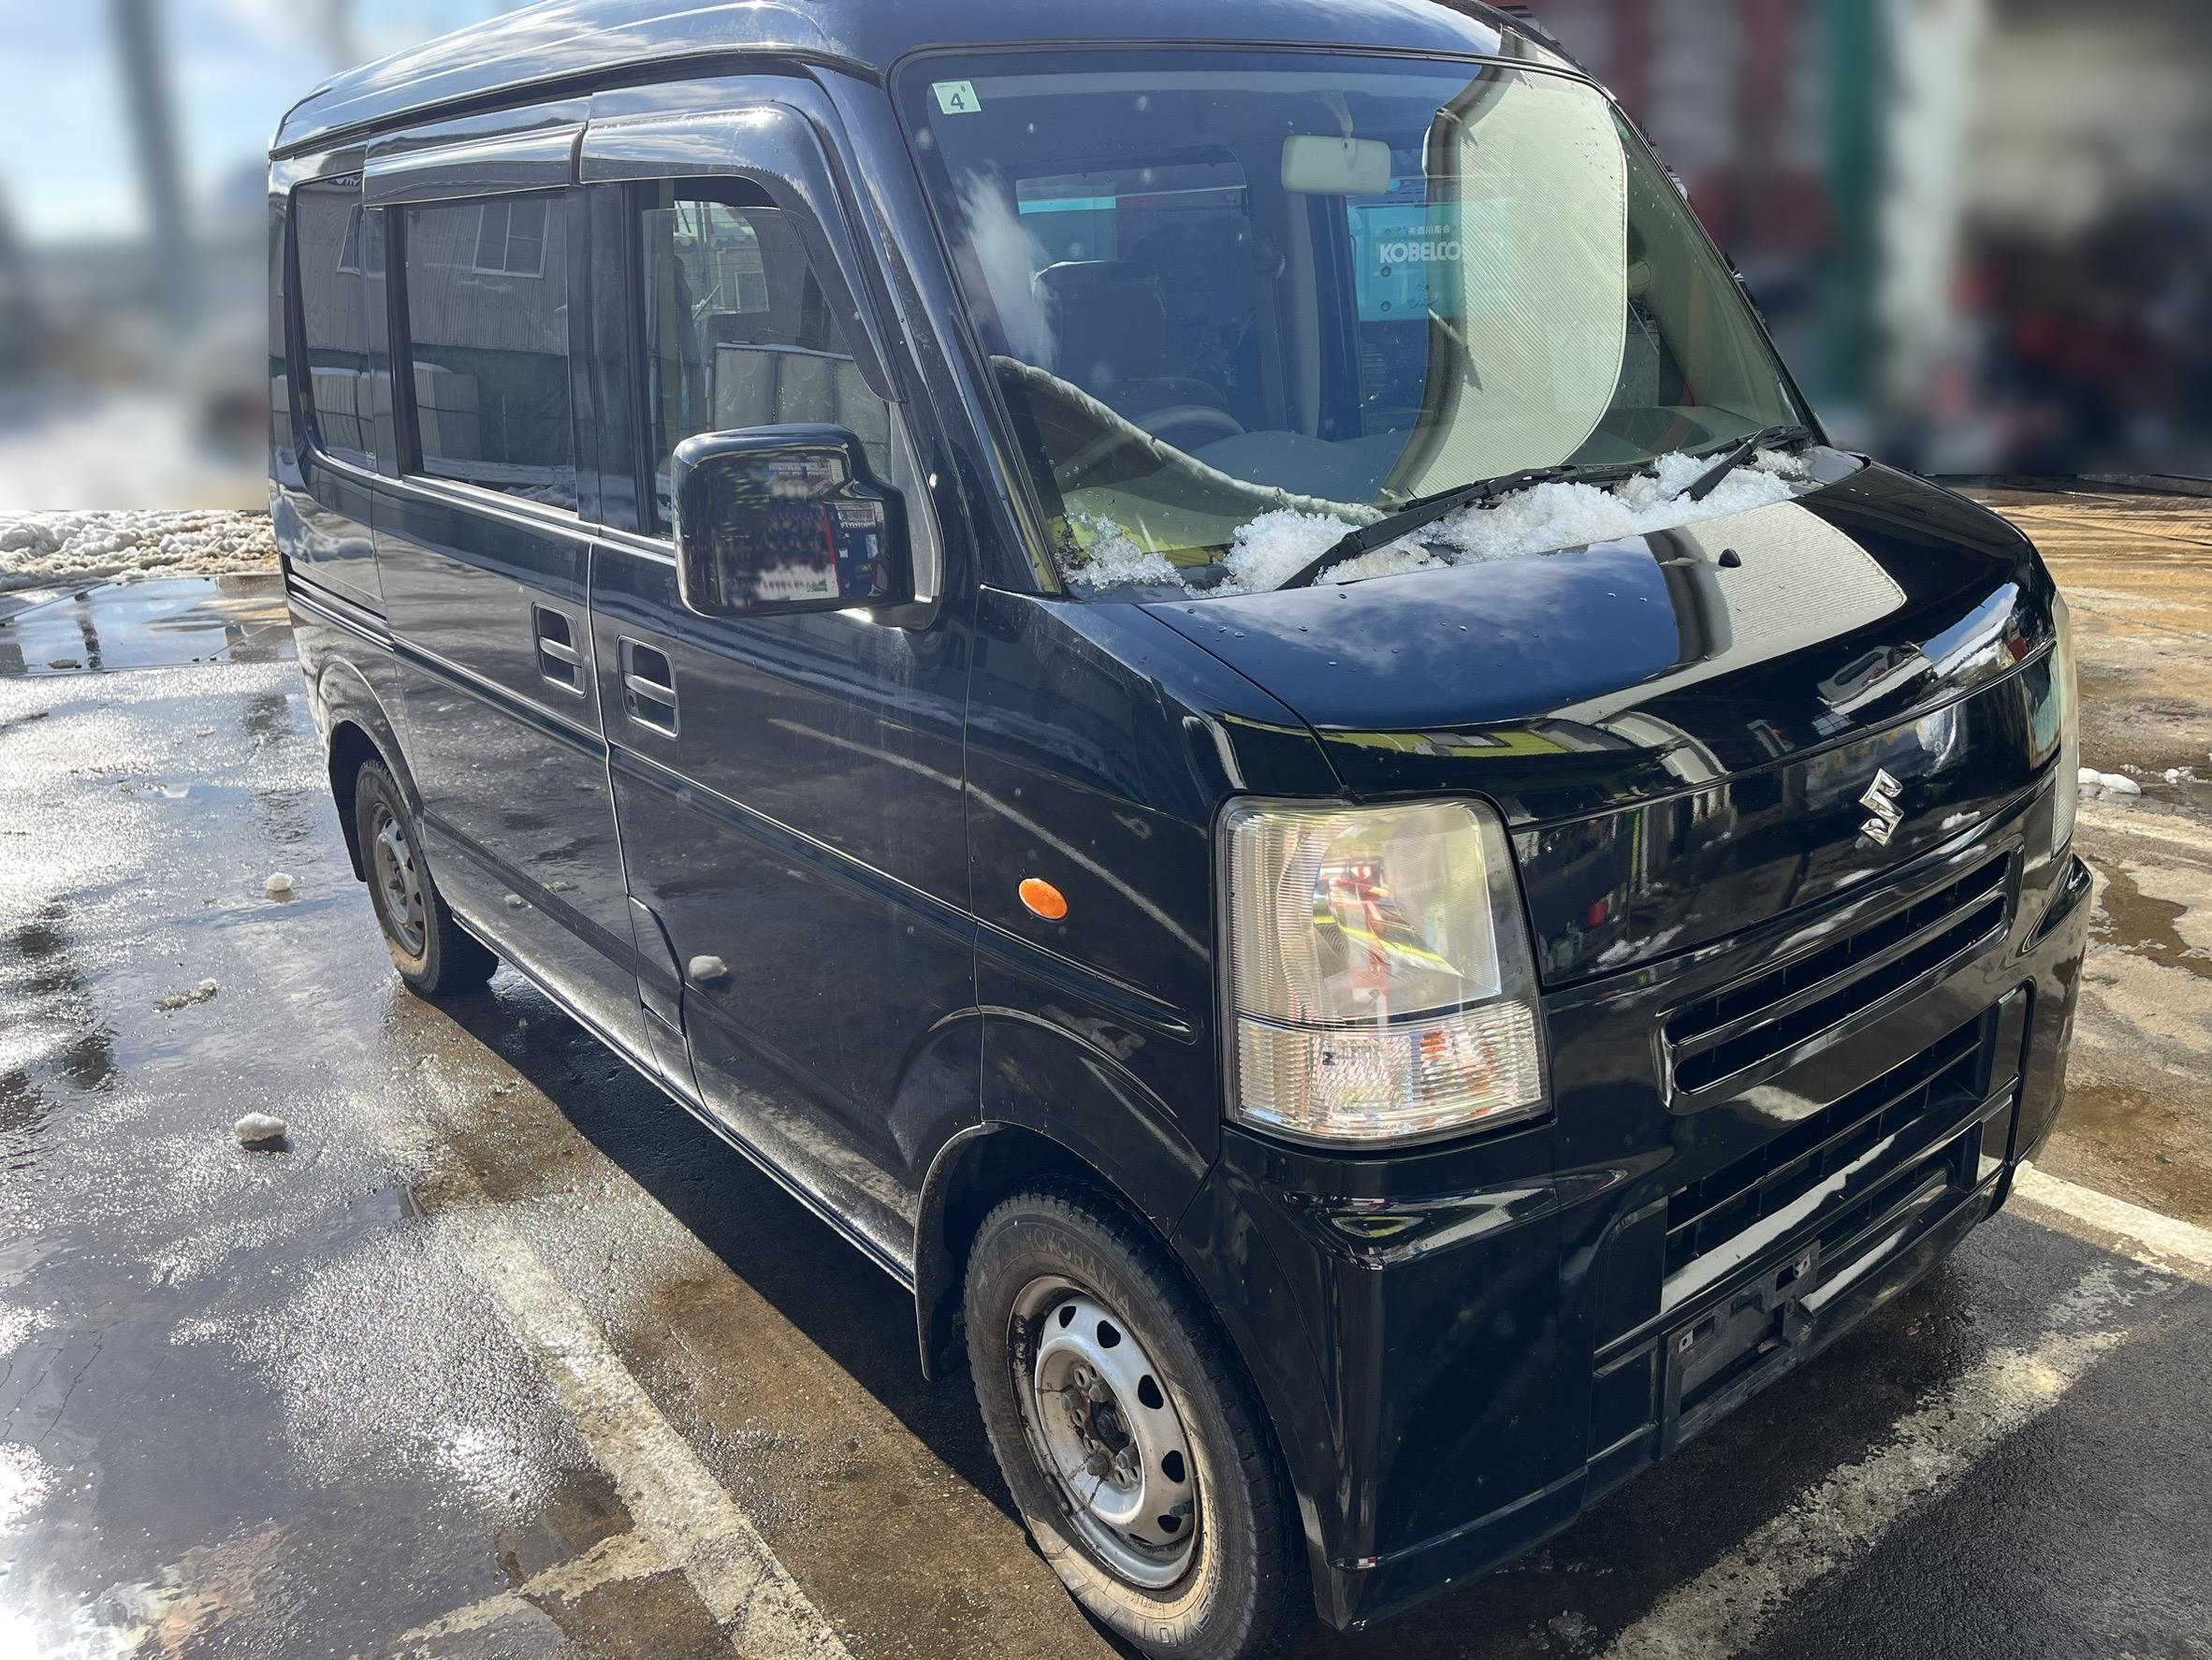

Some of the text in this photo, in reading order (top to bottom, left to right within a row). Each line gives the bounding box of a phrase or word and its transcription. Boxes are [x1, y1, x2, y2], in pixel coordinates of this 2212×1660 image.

[951, 93, 965, 110] 4
[1379, 240, 1462, 263] KOBELCO
[1025, 1227, 1132, 1318] YOKOHAMA
